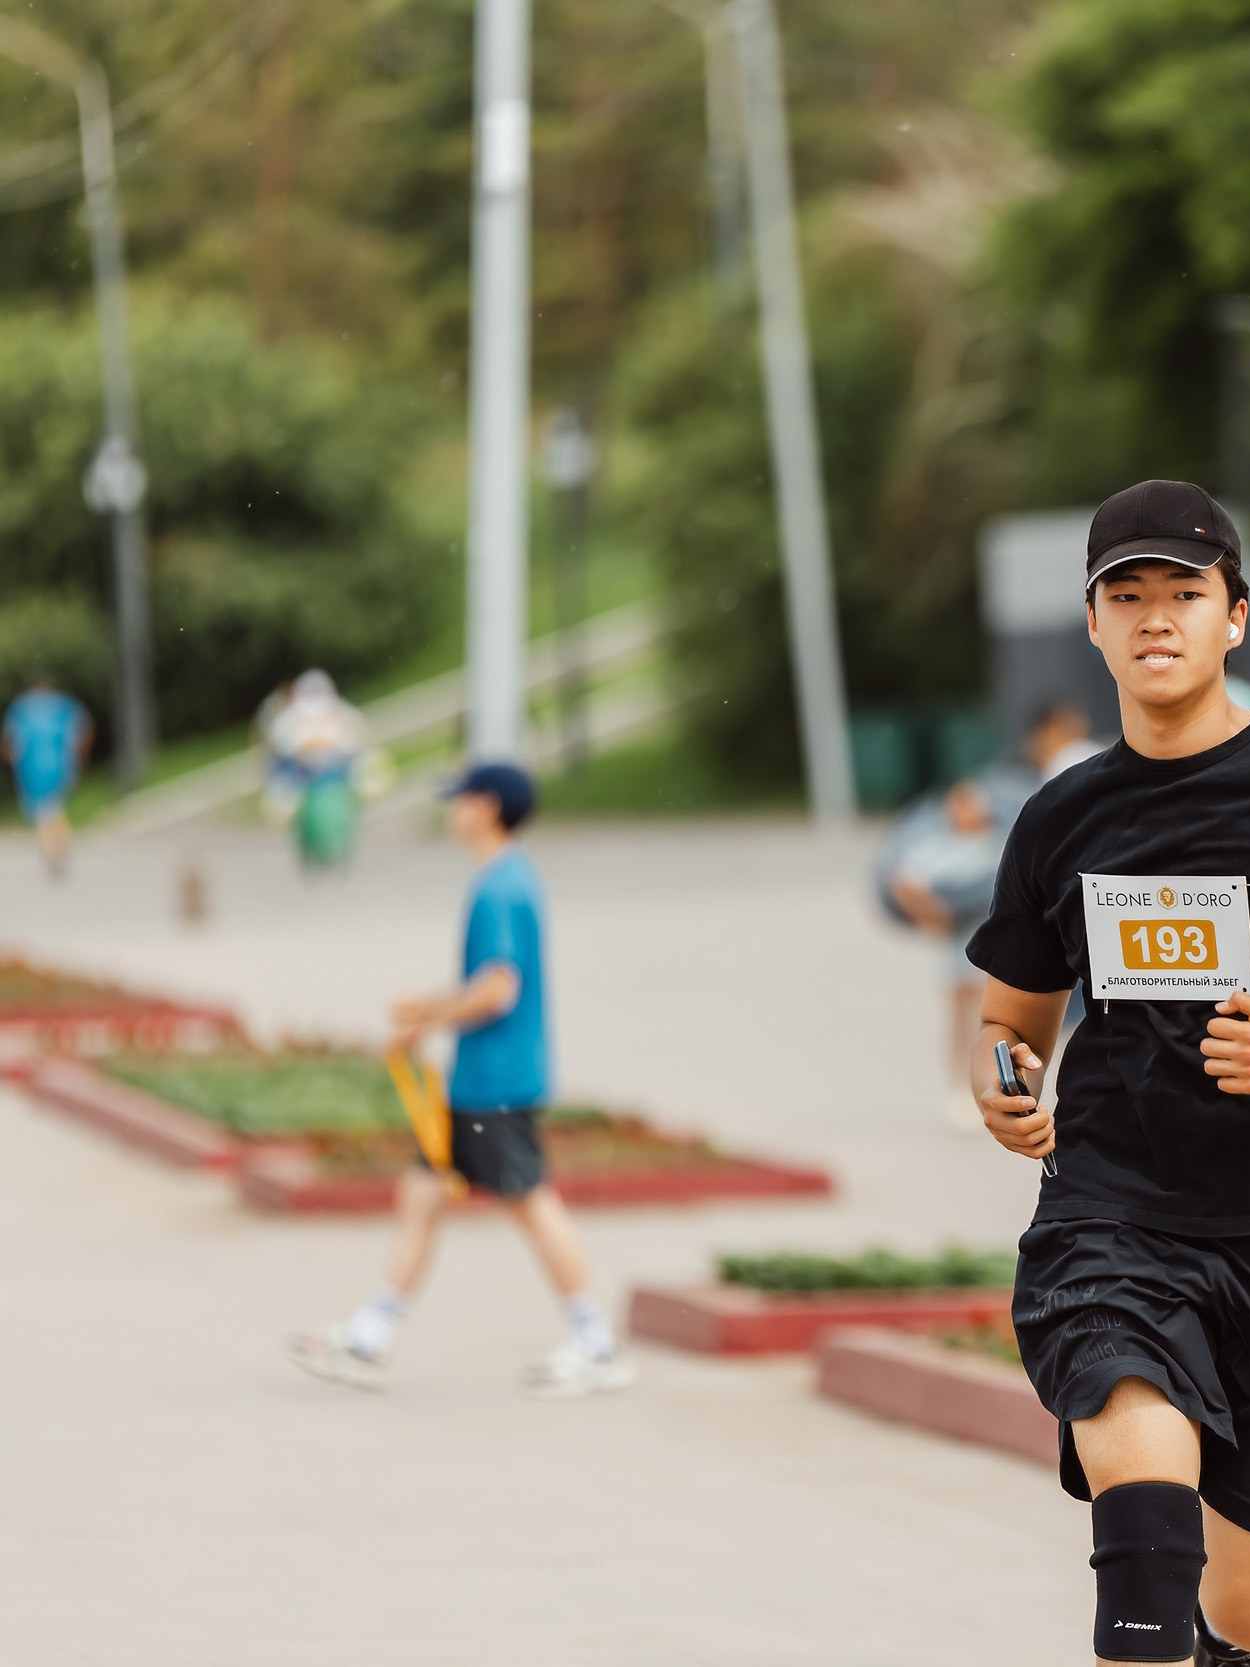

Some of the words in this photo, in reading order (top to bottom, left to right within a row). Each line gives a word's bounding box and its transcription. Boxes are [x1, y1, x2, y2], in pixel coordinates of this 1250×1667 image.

[1096, 892, 1152, 907] LEONE
[1183, 892, 1232, 907] D'ORO
[1131, 925, 1208, 964] 193
[1107, 976, 1210, 987] БЛАГОТВОРИТЕЛЬНЫЙ
[1212, 978, 1239, 987] ЗАБЕГ
[1124, 1622, 1163, 1631] DEMIX
